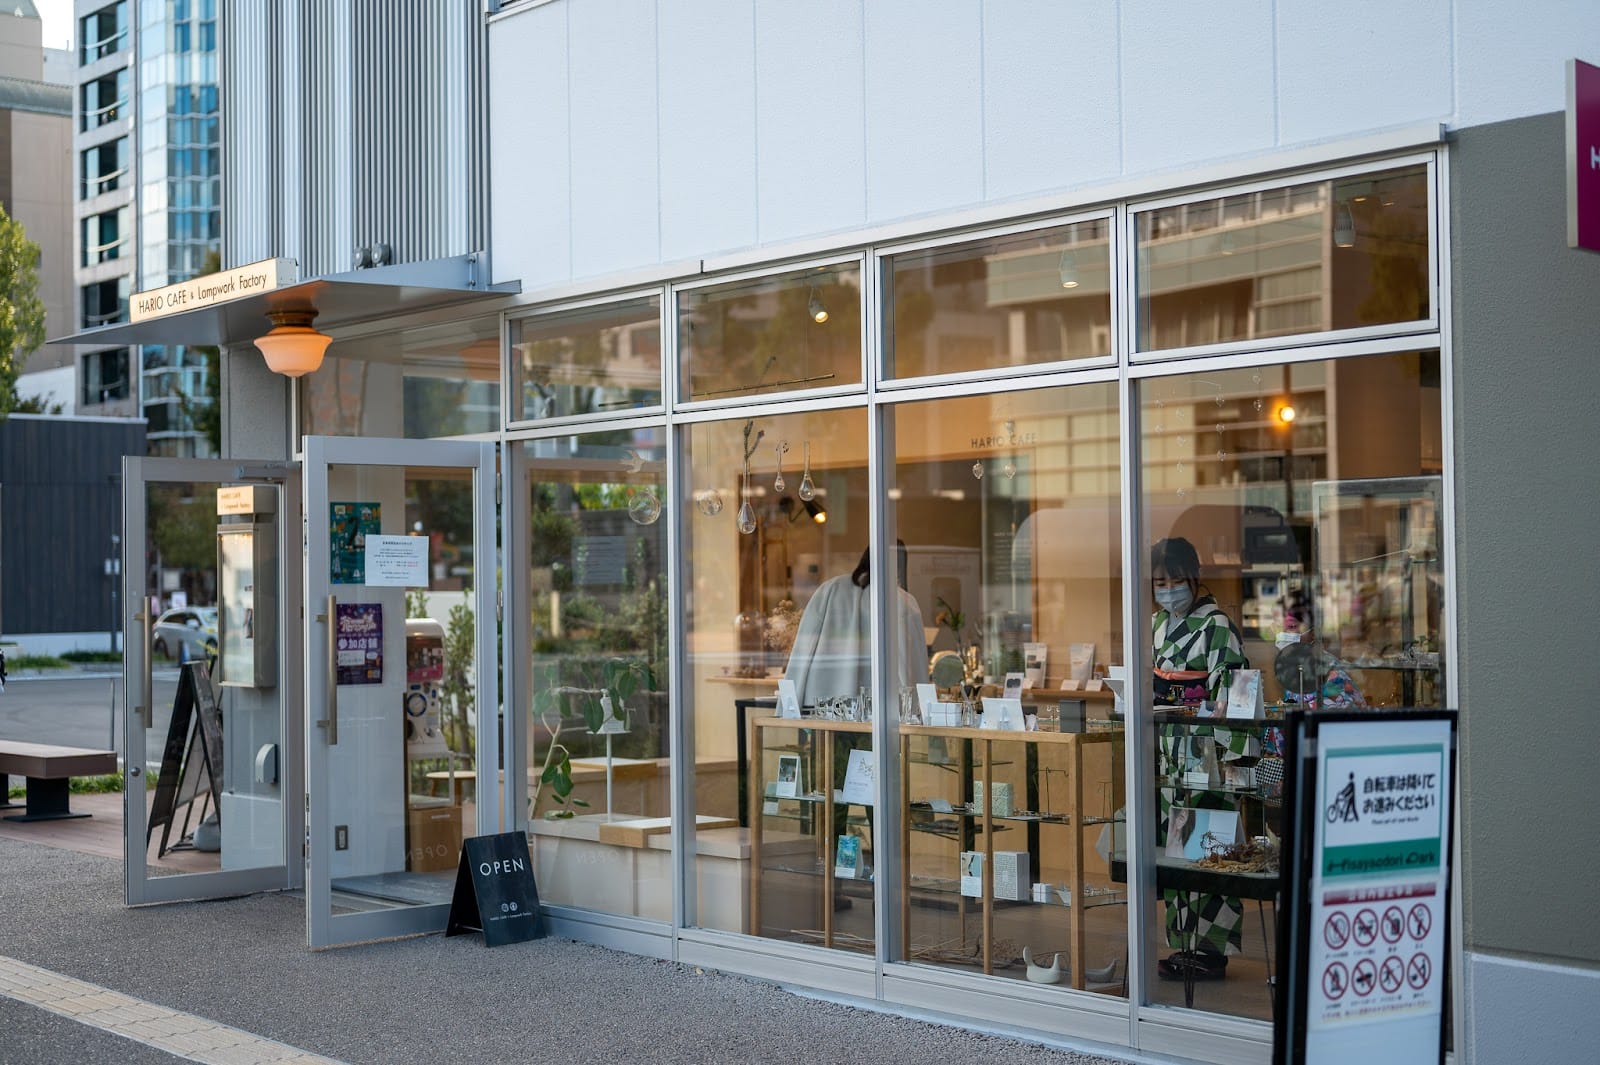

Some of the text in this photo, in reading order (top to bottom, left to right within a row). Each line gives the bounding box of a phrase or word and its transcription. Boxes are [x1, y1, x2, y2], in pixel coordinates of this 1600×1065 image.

[138, 295, 164, 314] HARIO
[166, 289, 187, 308] CAFE
[197, 276, 236, 301] Lampwork
[239, 273, 267, 290] Factory
[971, 432, 1037, 449] HARIO CAFE
[1363, 794, 1435, 814] お進みください
[480, 858, 524, 876] OPEN
